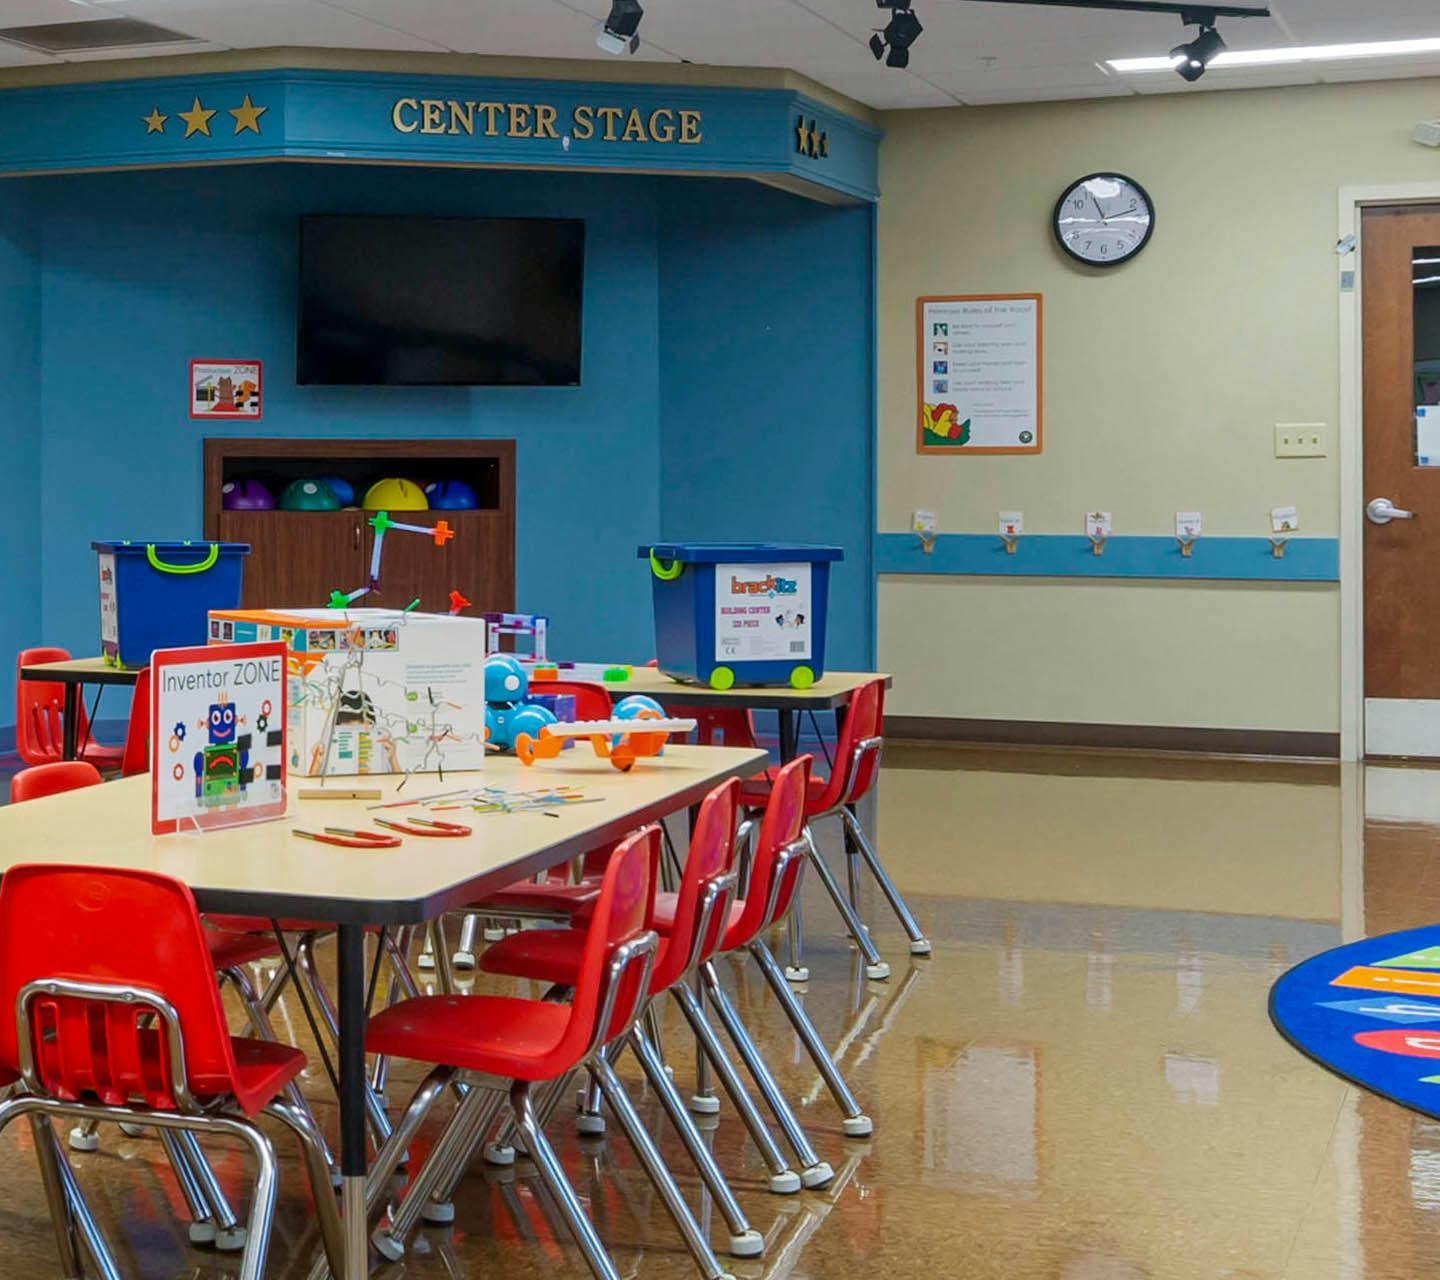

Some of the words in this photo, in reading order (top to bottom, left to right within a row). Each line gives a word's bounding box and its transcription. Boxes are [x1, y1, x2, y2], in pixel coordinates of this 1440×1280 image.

[392, 98, 559, 138] CENTER
[572, 106, 703, 144] STAGE
[1086, 241, 1093, 250] 7
[1100, 244, 1107, 254] 6
[1117, 241, 1124, 250] 5
[731, 574, 797, 594] brackitz
[162, 669, 228, 693] Inventor
[233, 660, 280, 686] ZONE
